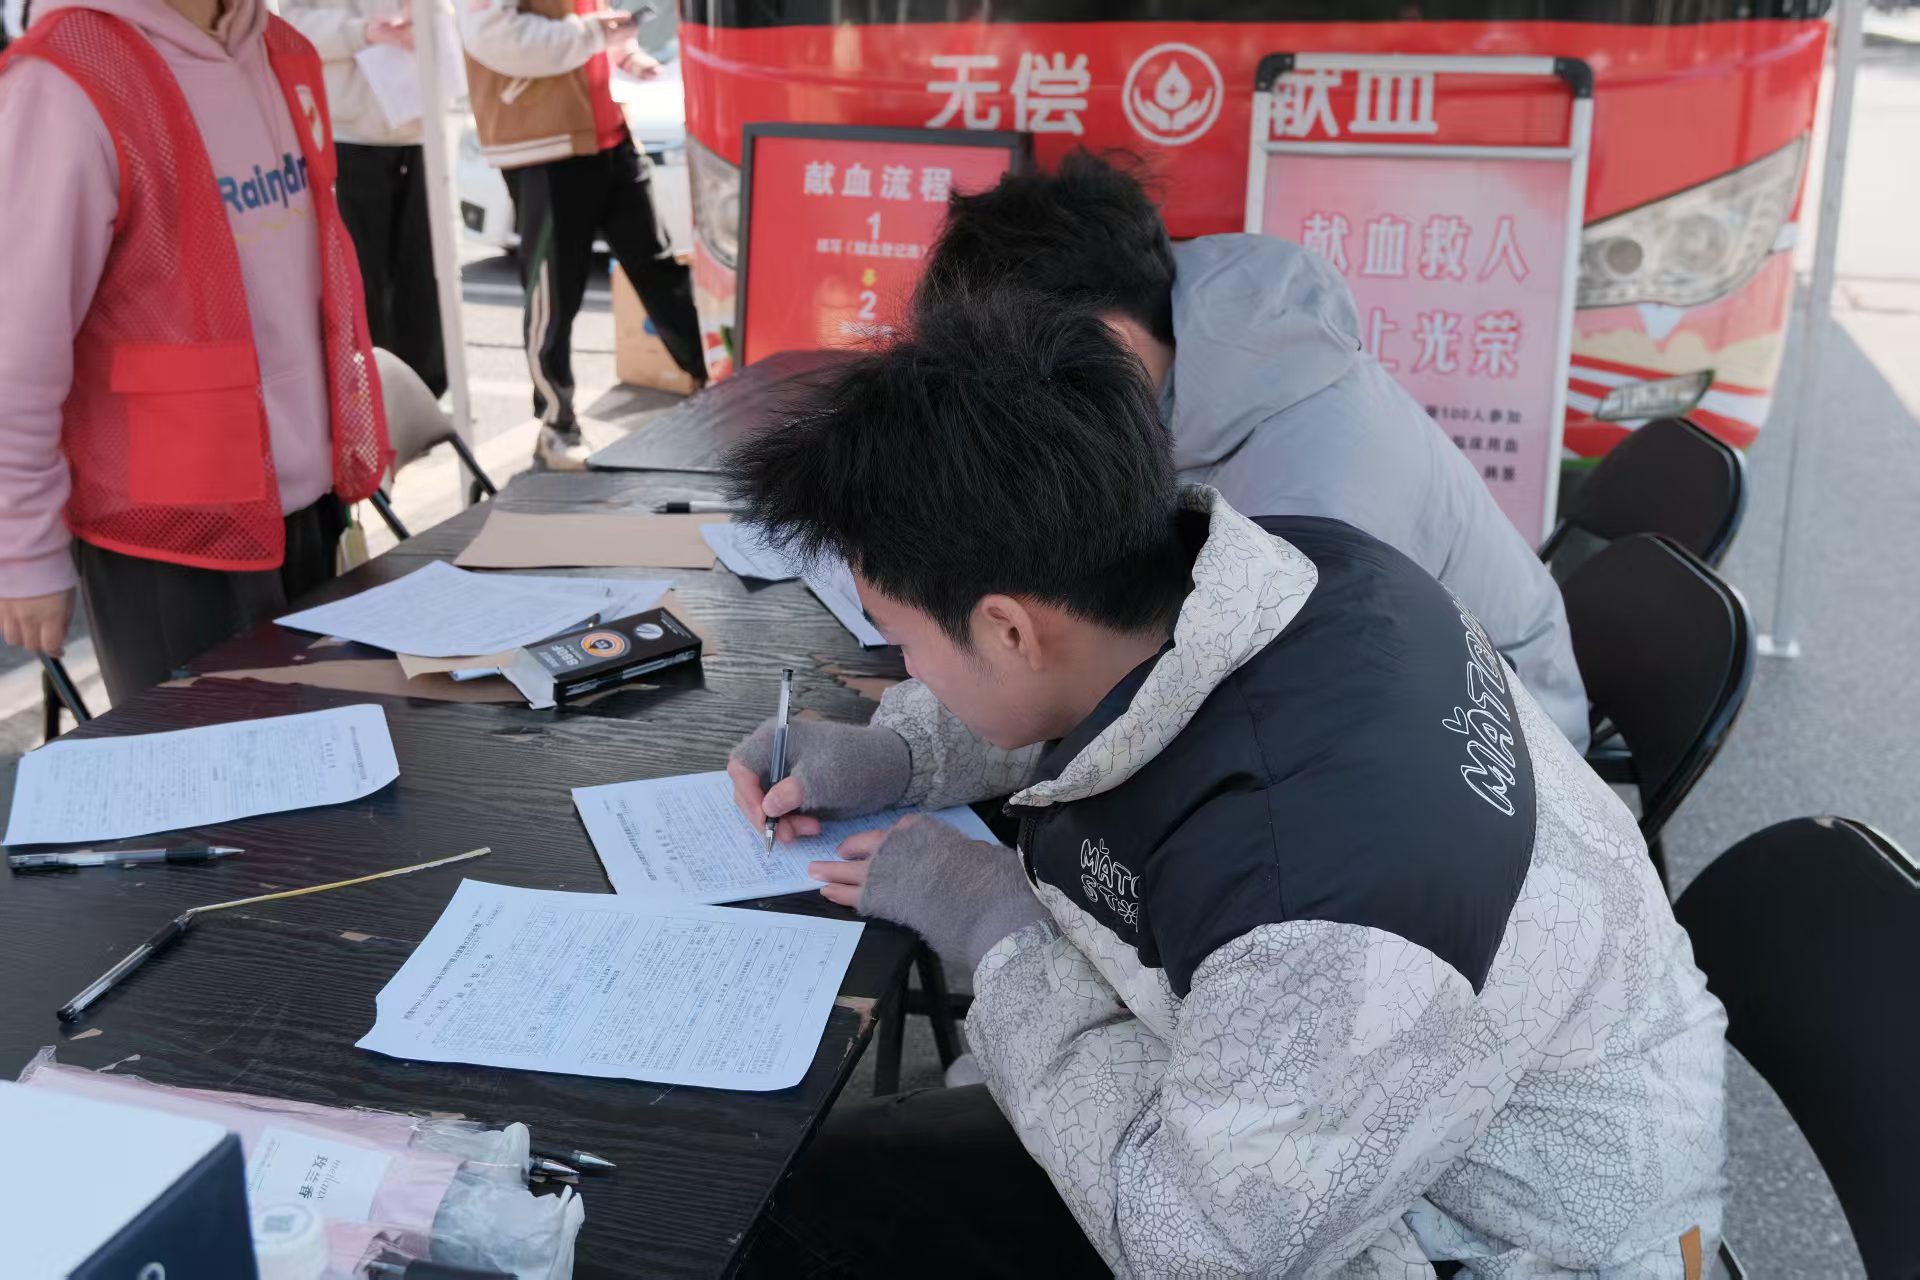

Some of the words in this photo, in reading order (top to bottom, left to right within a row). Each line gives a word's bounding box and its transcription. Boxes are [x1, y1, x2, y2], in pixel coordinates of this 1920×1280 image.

[926, 53, 1092, 136] 无偿
[1271, 68, 1439, 138] 献血
[803, 160, 953, 203] 献血流程
[866, 211, 881, 240] 1
[1299, 209, 1531, 284] 献血救人
[858, 290, 878, 320] 2
[298, 1153, 329, 1199] 玫兰香
